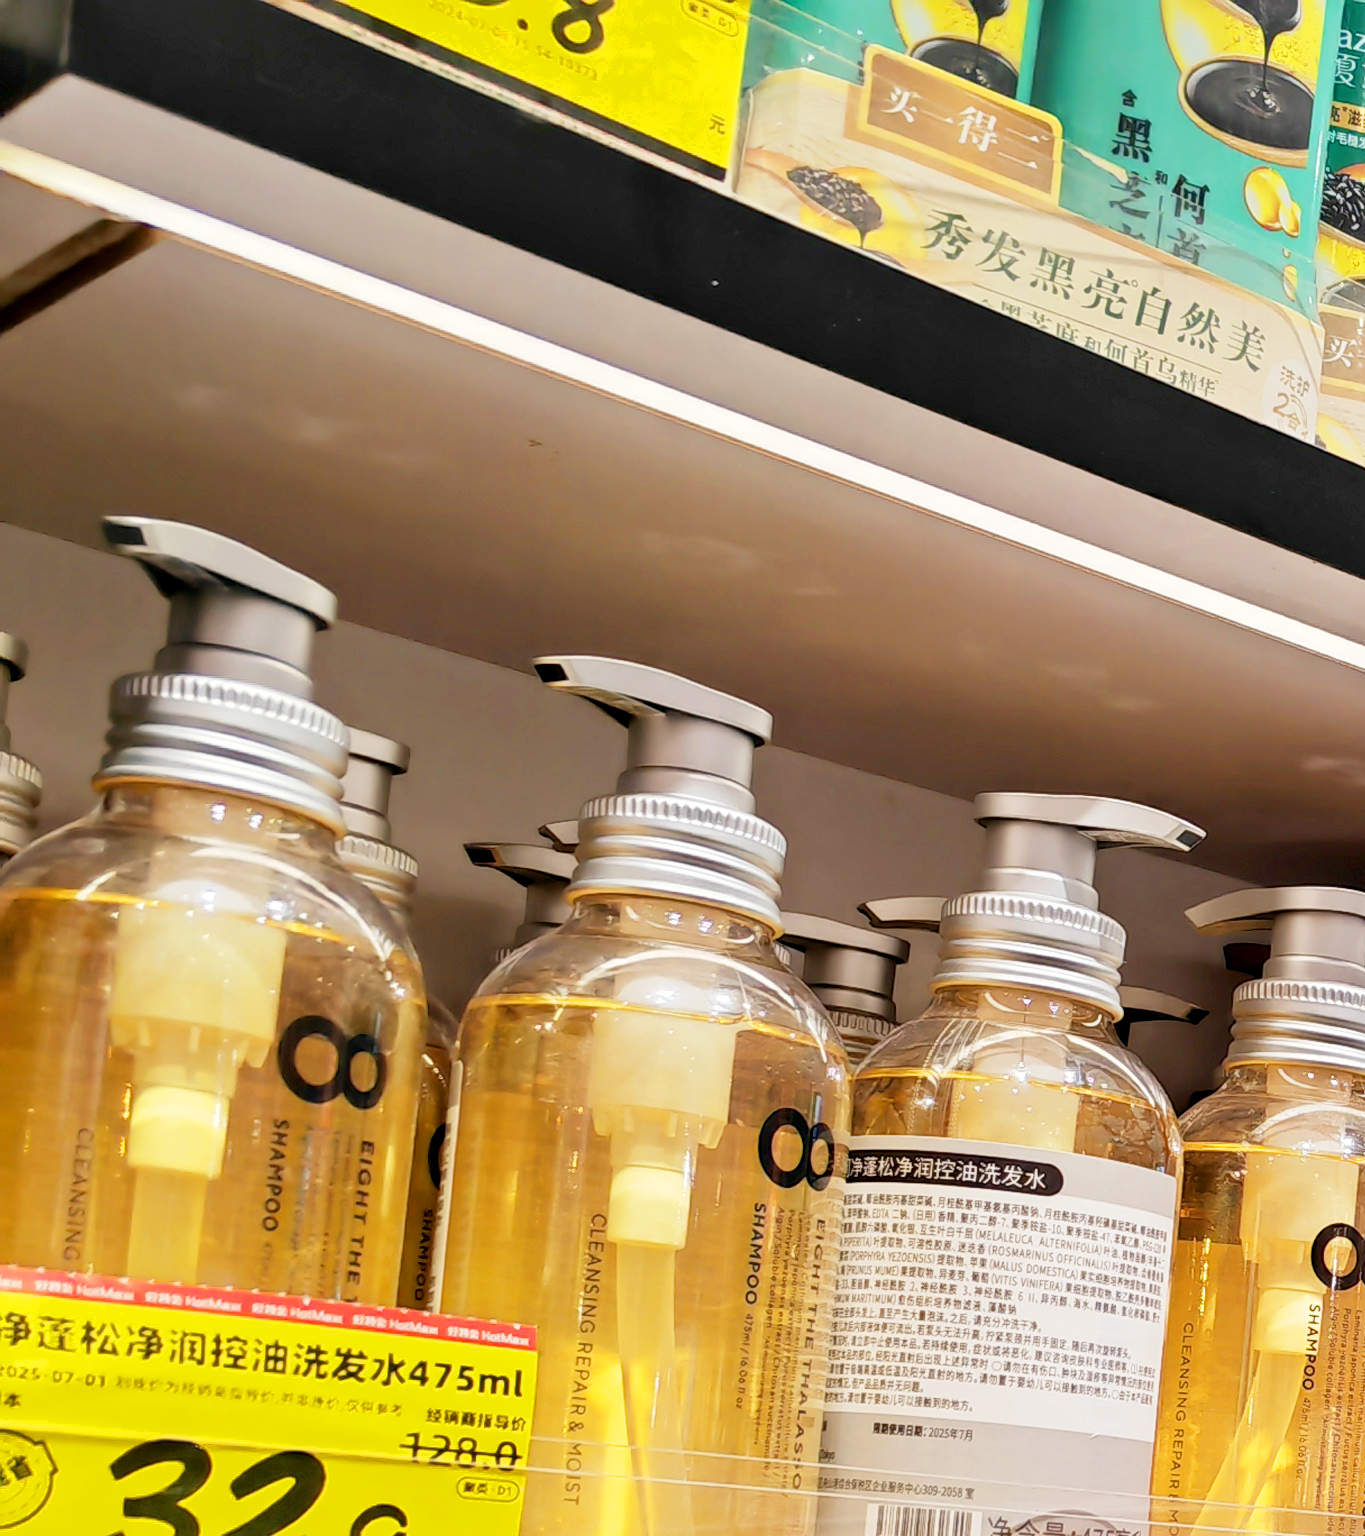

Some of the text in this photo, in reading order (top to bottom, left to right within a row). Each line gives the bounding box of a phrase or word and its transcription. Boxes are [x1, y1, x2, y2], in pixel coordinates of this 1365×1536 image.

[708, 115, 727, 135] 元
[884, 86, 1042, 170] 买一得二
[1121, 89, 1139, 107] 含
[260, 1118, 292, 1234] SHAMPOO
[357, 1138, 377, 1217] EIGHT
[744, 1202, 767, 1305] SHAMPOO
[803, 1219, 826, 1351] EIGHT THE
[563, 1213, 608, 1506] CLEANSING REPAIR MOIST
[1178, 1322, 1194, 1412] CLEANSING
[1301, 1303, 1322, 1392] SHAMPOO
